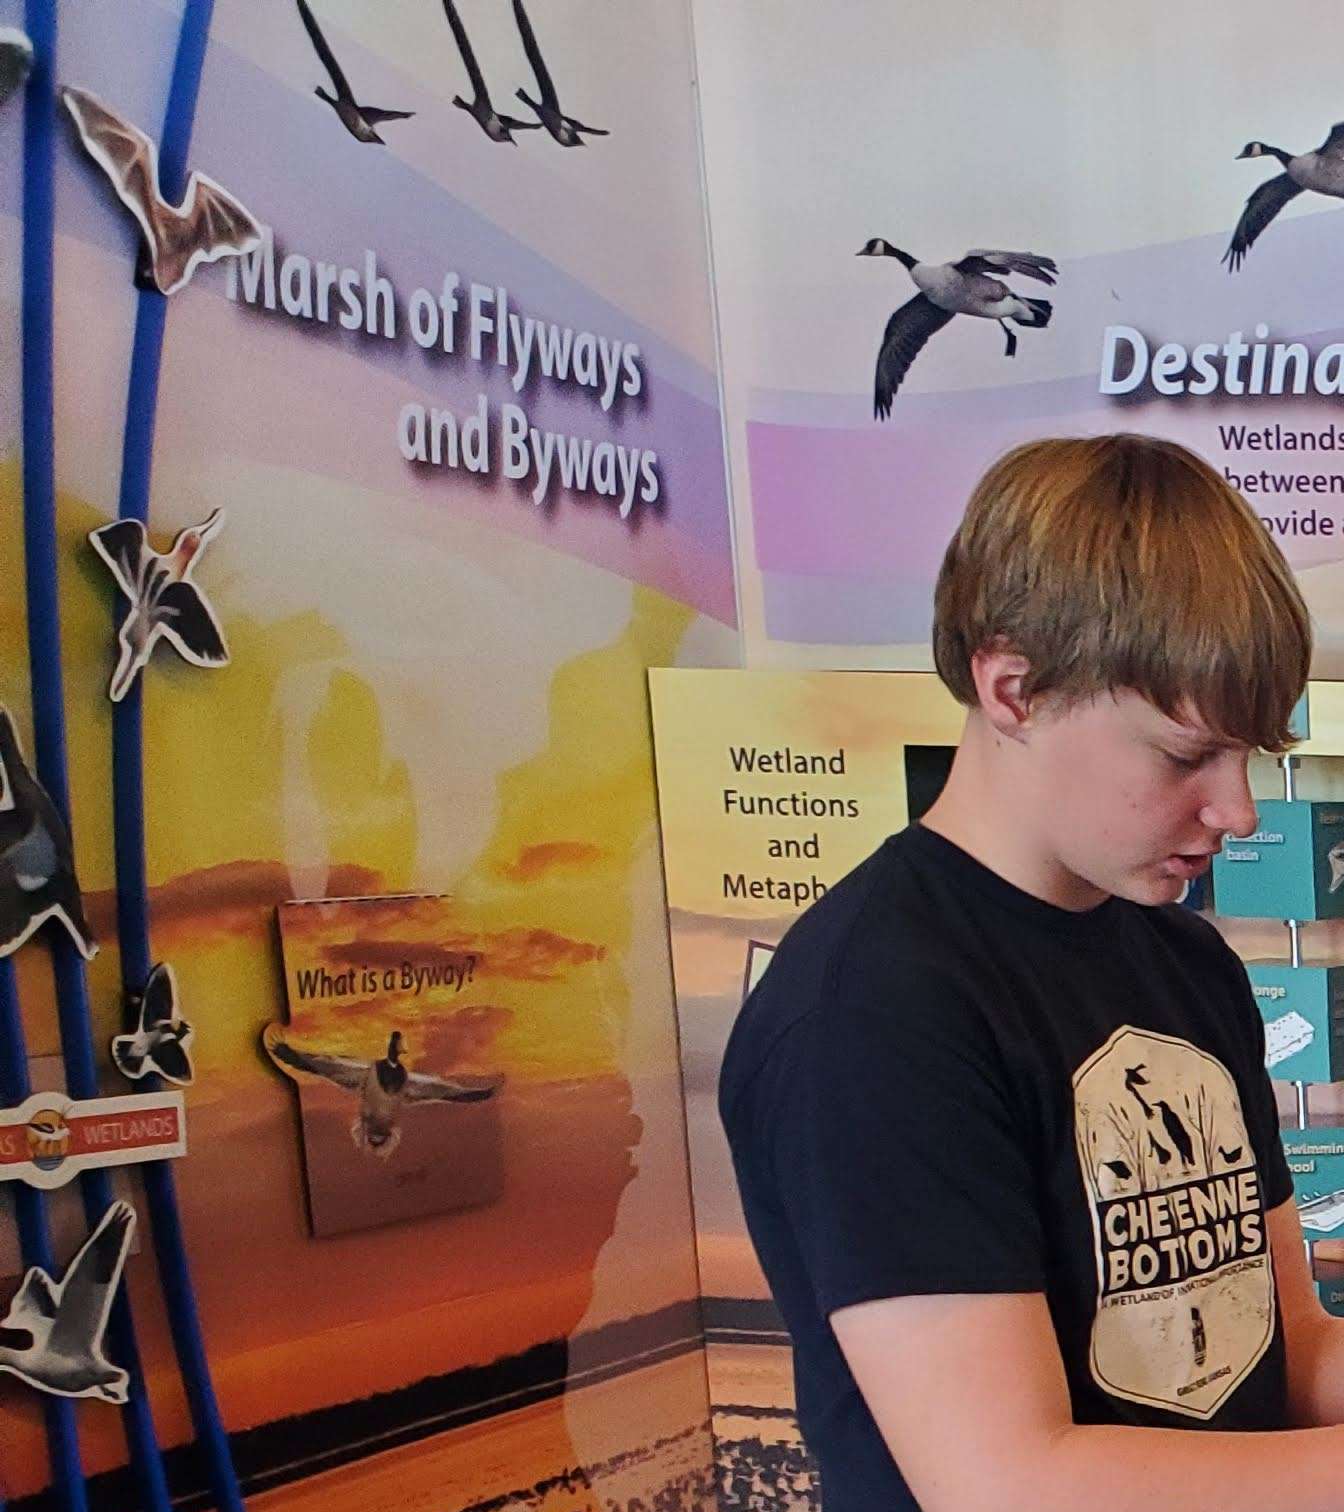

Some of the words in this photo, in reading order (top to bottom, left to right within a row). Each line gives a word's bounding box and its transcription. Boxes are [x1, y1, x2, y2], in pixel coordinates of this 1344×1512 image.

[226, 227, 396, 340] Marsh
[409, 271, 459, 353] of
[470, 282, 643, 412] Flyways
[400, 395, 489, 473] and
[503, 403, 660, 519] Byways
[730, 747, 845, 775] Wetland
[723, 790, 859, 818] Functions
[768, 833, 820, 859] and
[722, 873, 828, 906] Metaph
[297, 967, 354, 999] What
[362, 966, 377, 993] is
[383, 969, 396, 990] a
[400, 956, 477, 995] Byway?
[83, 1116, 174, 1145] WETLANDS
